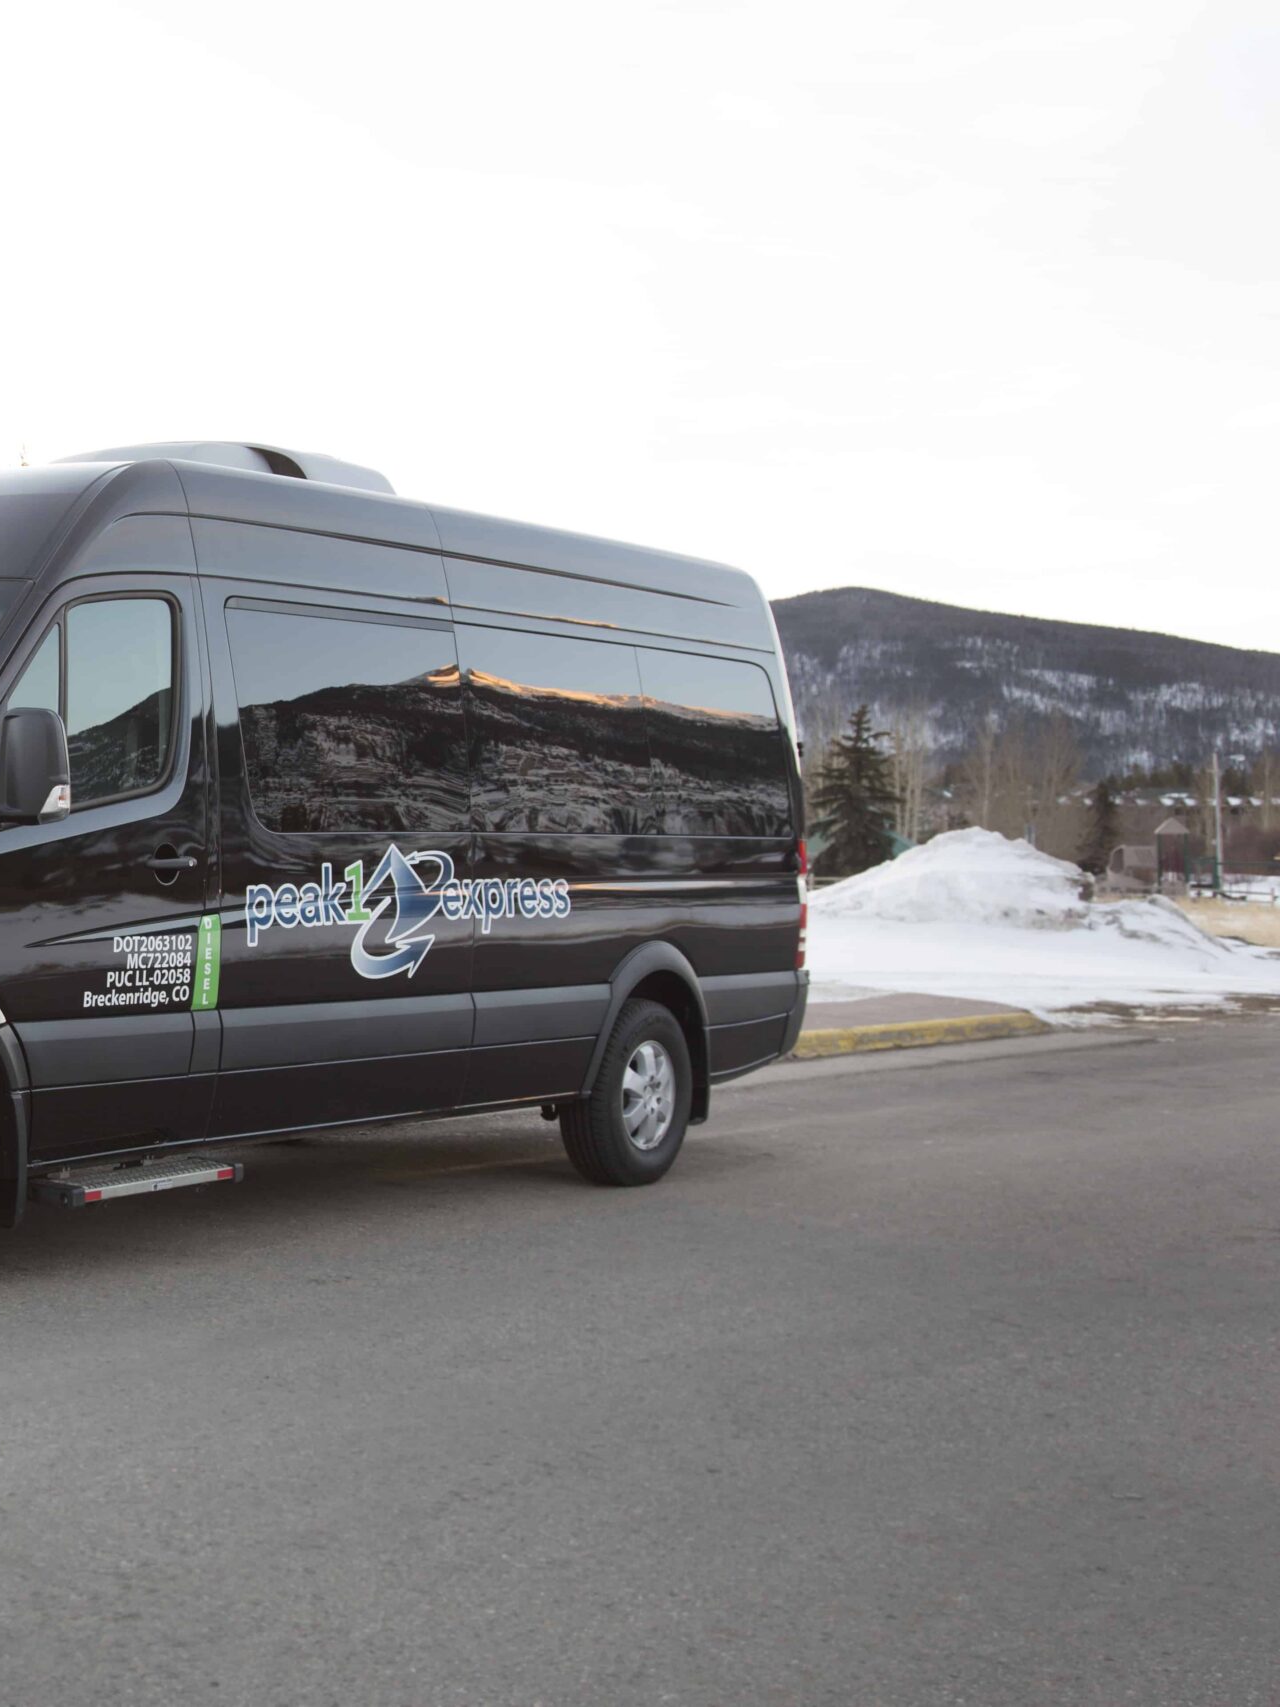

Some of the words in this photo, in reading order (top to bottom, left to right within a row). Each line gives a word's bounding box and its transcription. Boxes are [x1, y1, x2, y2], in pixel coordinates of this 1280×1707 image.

[440, 878, 571, 935] express
[113, 935, 192, 953] DOT2063102
[127, 952, 192, 970] MC722084
[202, 917, 213, 1005] DIESEL
[106, 970, 133, 988] PUC
[135, 968, 191, 987] LL-02058
[83, 987, 170, 1008] Breckenridge,
[172, 985, 190, 1002] CO
